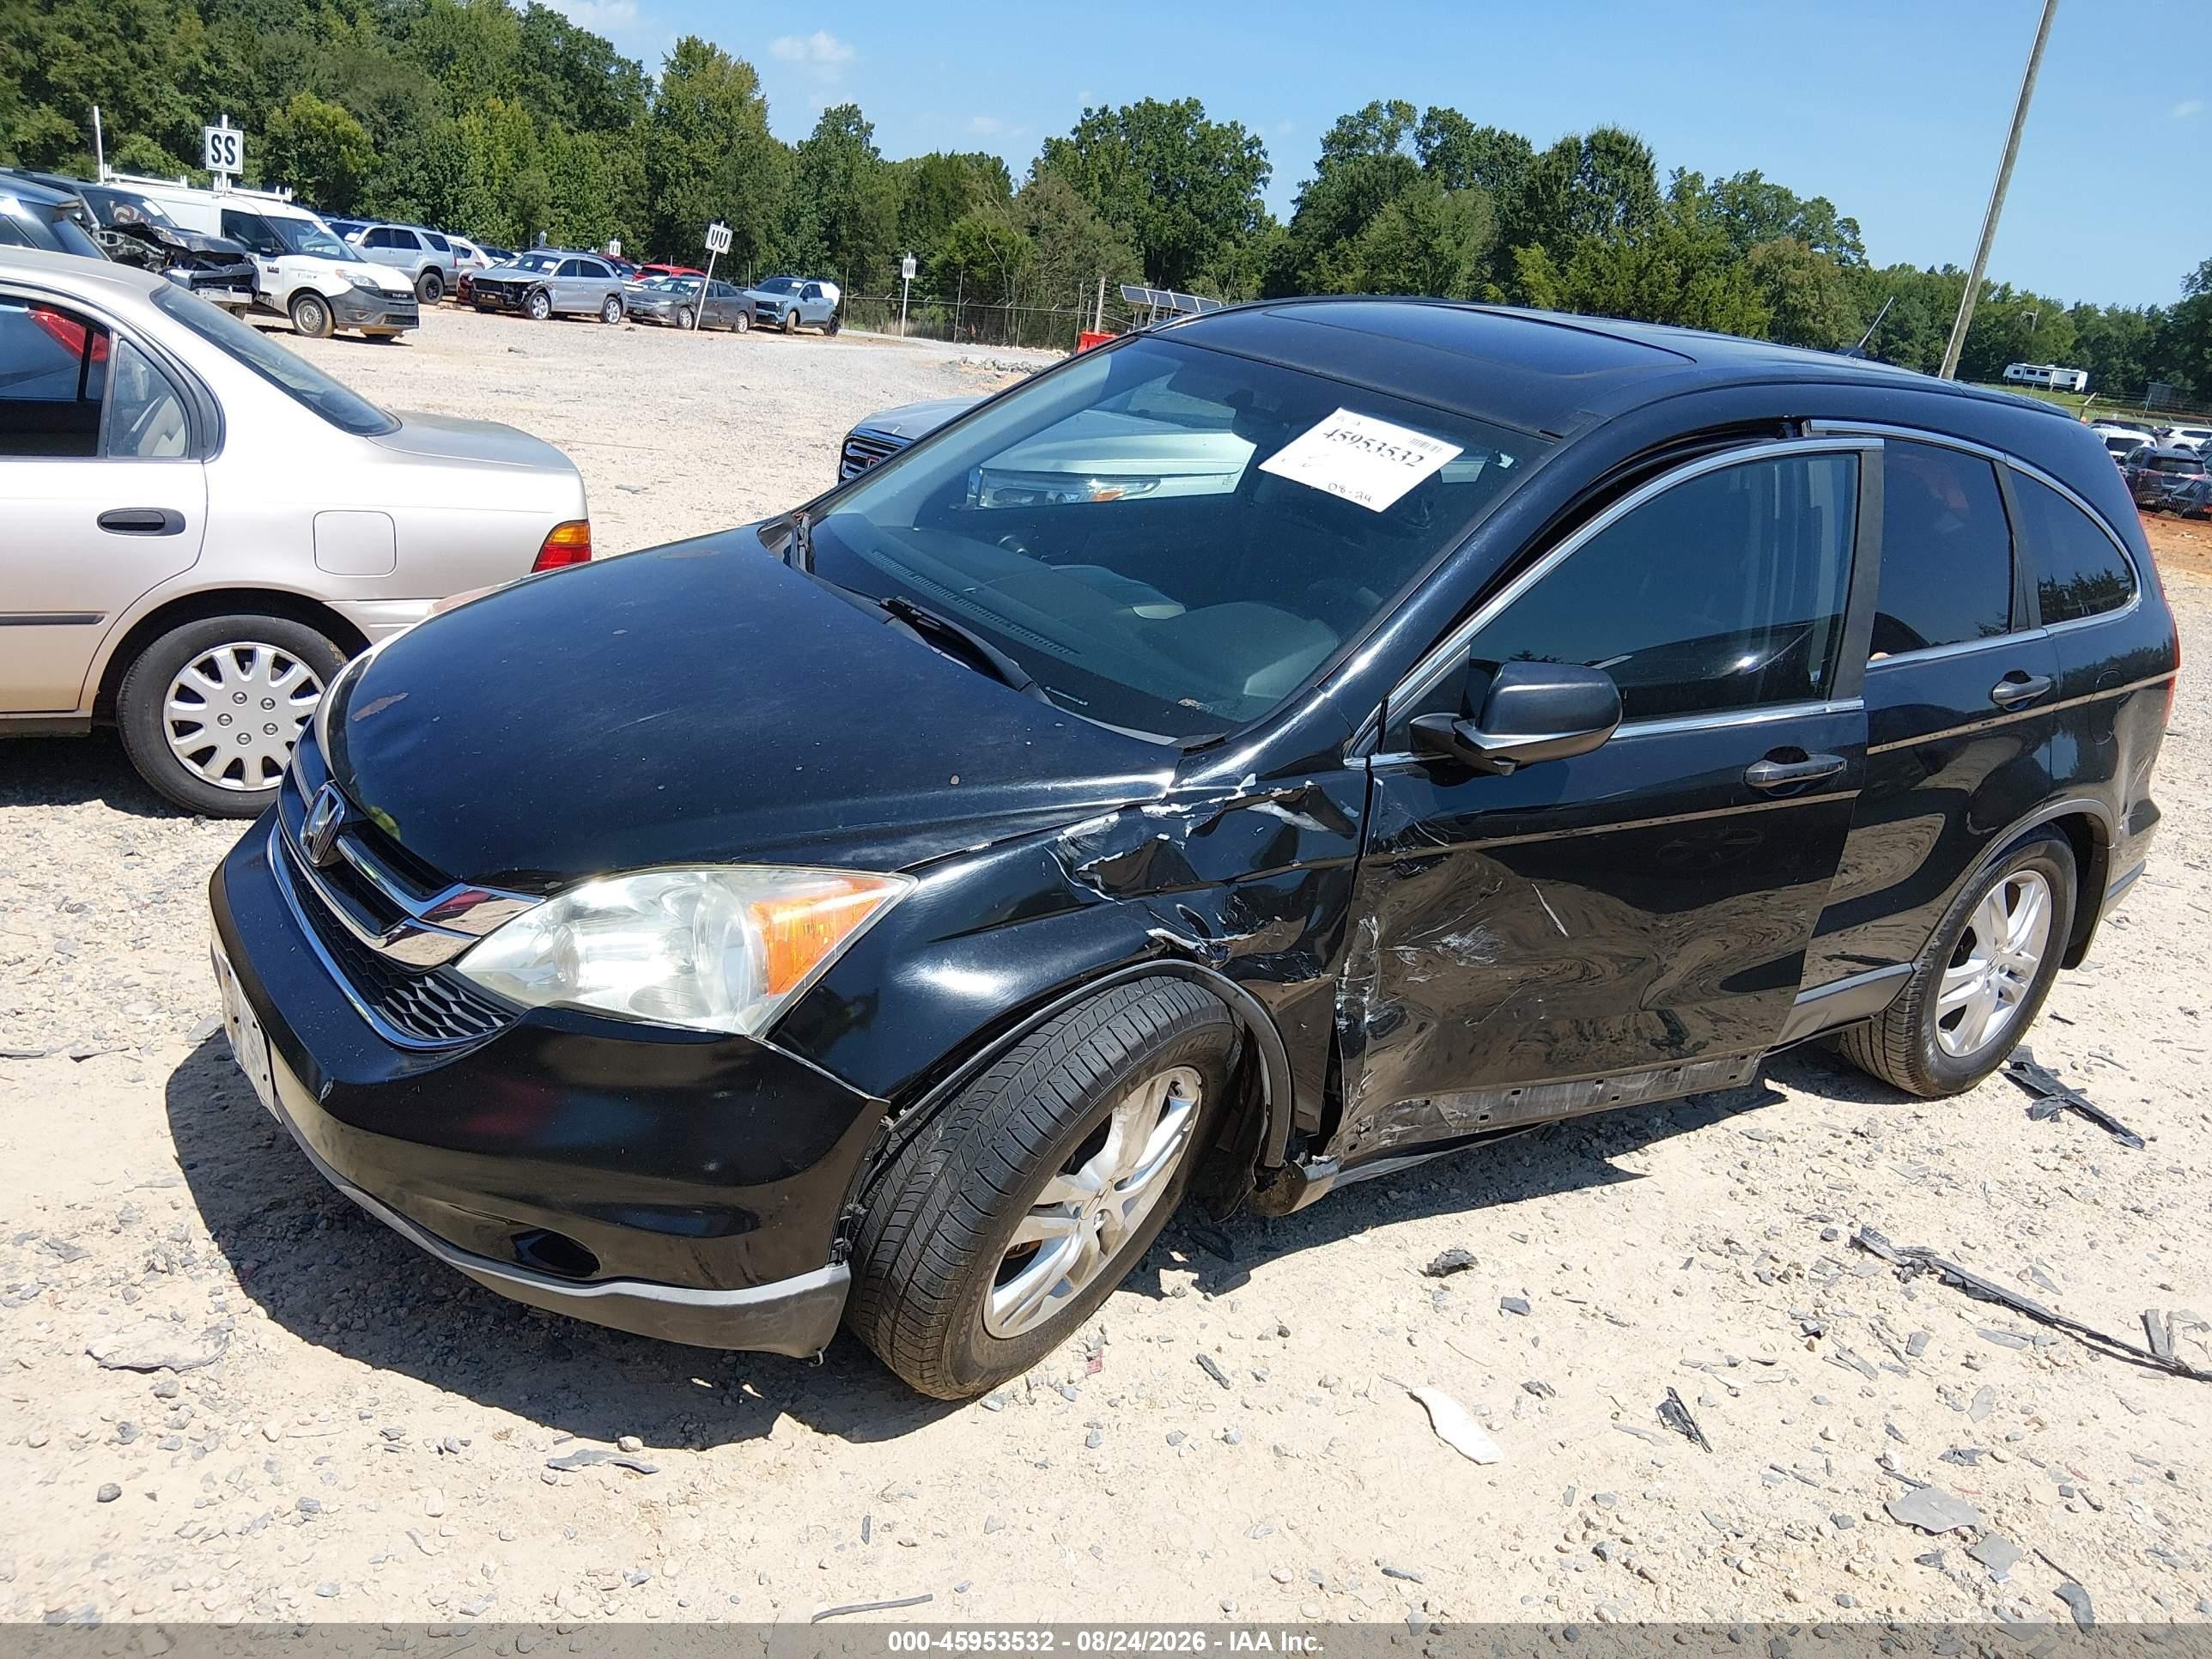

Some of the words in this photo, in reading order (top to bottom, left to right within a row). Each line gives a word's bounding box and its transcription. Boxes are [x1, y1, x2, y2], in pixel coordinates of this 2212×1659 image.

[211, 133, 236, 166] SS
[710, 228, 729, 249] UU
[1322, 428, 1425, 467] 45953532
